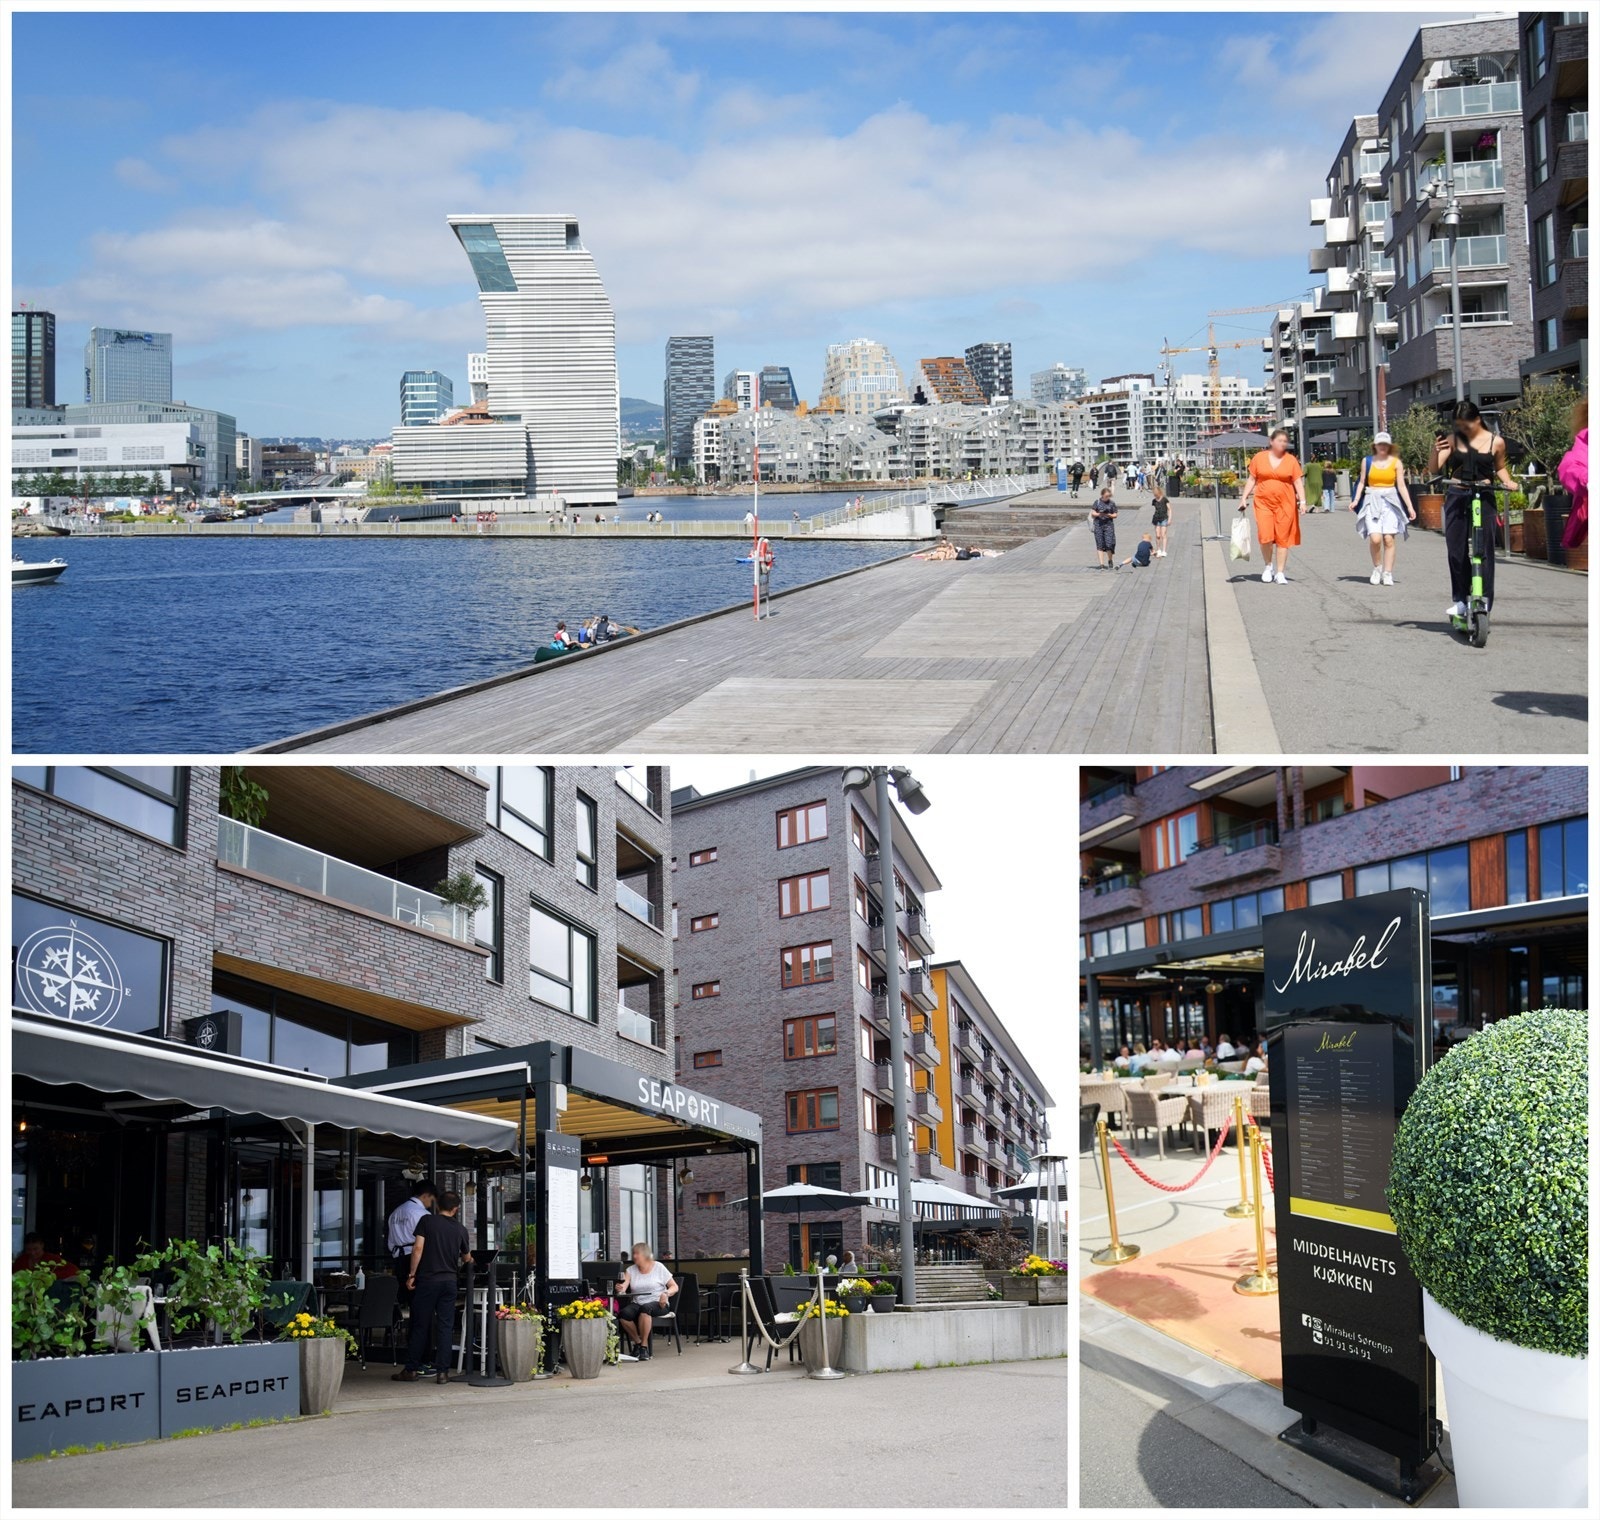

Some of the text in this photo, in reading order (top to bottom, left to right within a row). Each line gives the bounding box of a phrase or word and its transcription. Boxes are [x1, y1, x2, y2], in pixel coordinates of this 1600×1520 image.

[70, 919, 78, 928] N
[1272, 916, 1402, 994] Mirabel
[125, 988, 132, 997] E
[1314, 1031, 1357, 1053] Mirabel
[638, 1077, 720, 1126] SEAPORT
[547, 1142, 579, 1154] SEAPORT
[1293, 1238, 1397, 1276] MIDDELHAVETS
[1313, 1265, 1374, 1294] KJØKKEN
[1323, 1322, 1393, 1354] Mirabel Sørenga
[1324, 1336, 1371, 1360] 91 91 54 91
[176, 1376, 290, 1403] SEAPORT
[18, 1392, 146, 1423] EAPORT
